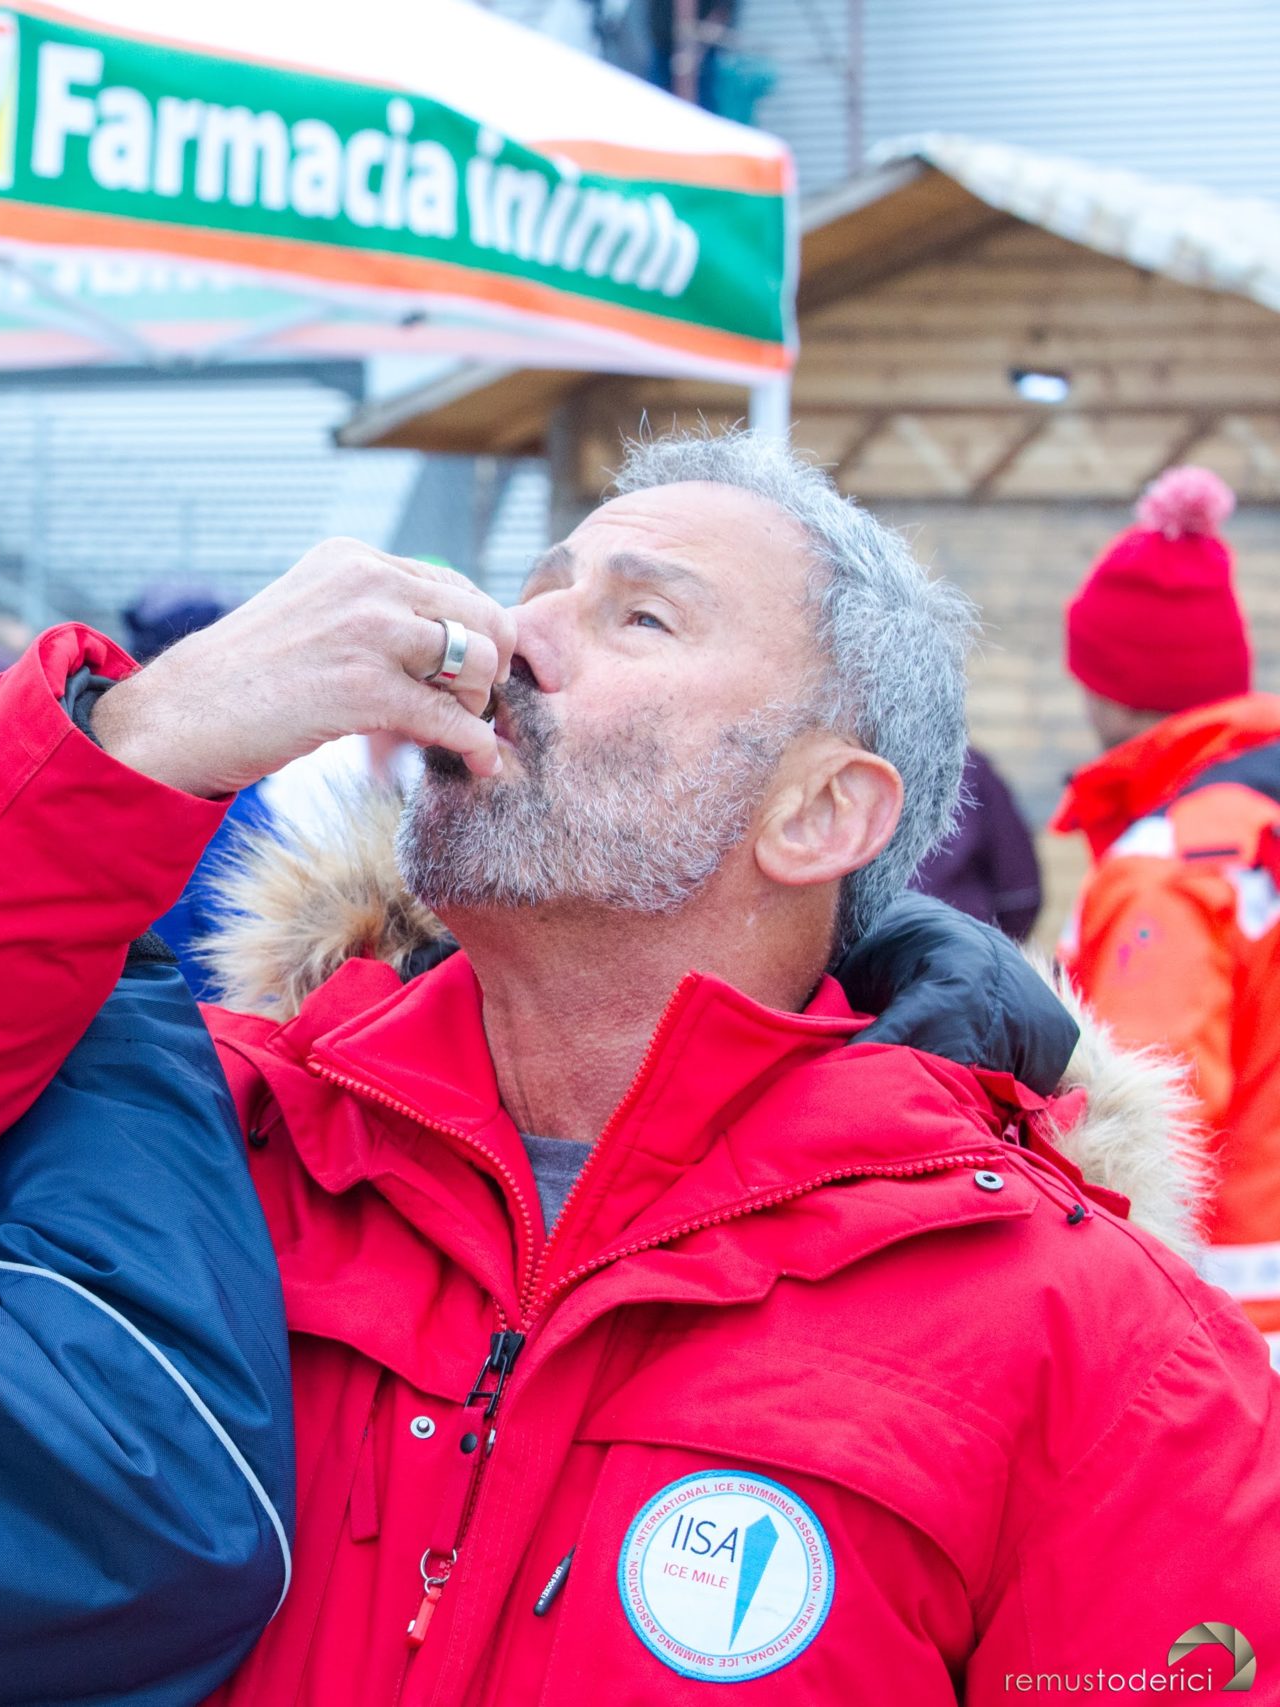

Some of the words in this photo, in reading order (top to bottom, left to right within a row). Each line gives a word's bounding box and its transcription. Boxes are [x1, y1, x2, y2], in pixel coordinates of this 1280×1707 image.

[31, 41, 458, 240] Farmacia
[636, 1485, 710, 1547] INTERNATIONAL
[714, 1482, 734, 1492] ICE
[738, 1483, 795, 1516] SWIMMING
[794, 1516, 822, 1592] ASSOCIATION
[671, 1514, 739, 1563] IISA
[628, 1560, 658, 1634] ASSOCIATION
[663, 1562, 688, 1579] ICE
[691, 1570, 729, 1589] MILE
[657, 1634, 714, 1667] SWIMMING
[744, 1603, 816, 1665] INTERNATIONAL
[718, 1658, 739, 1667] ICE
